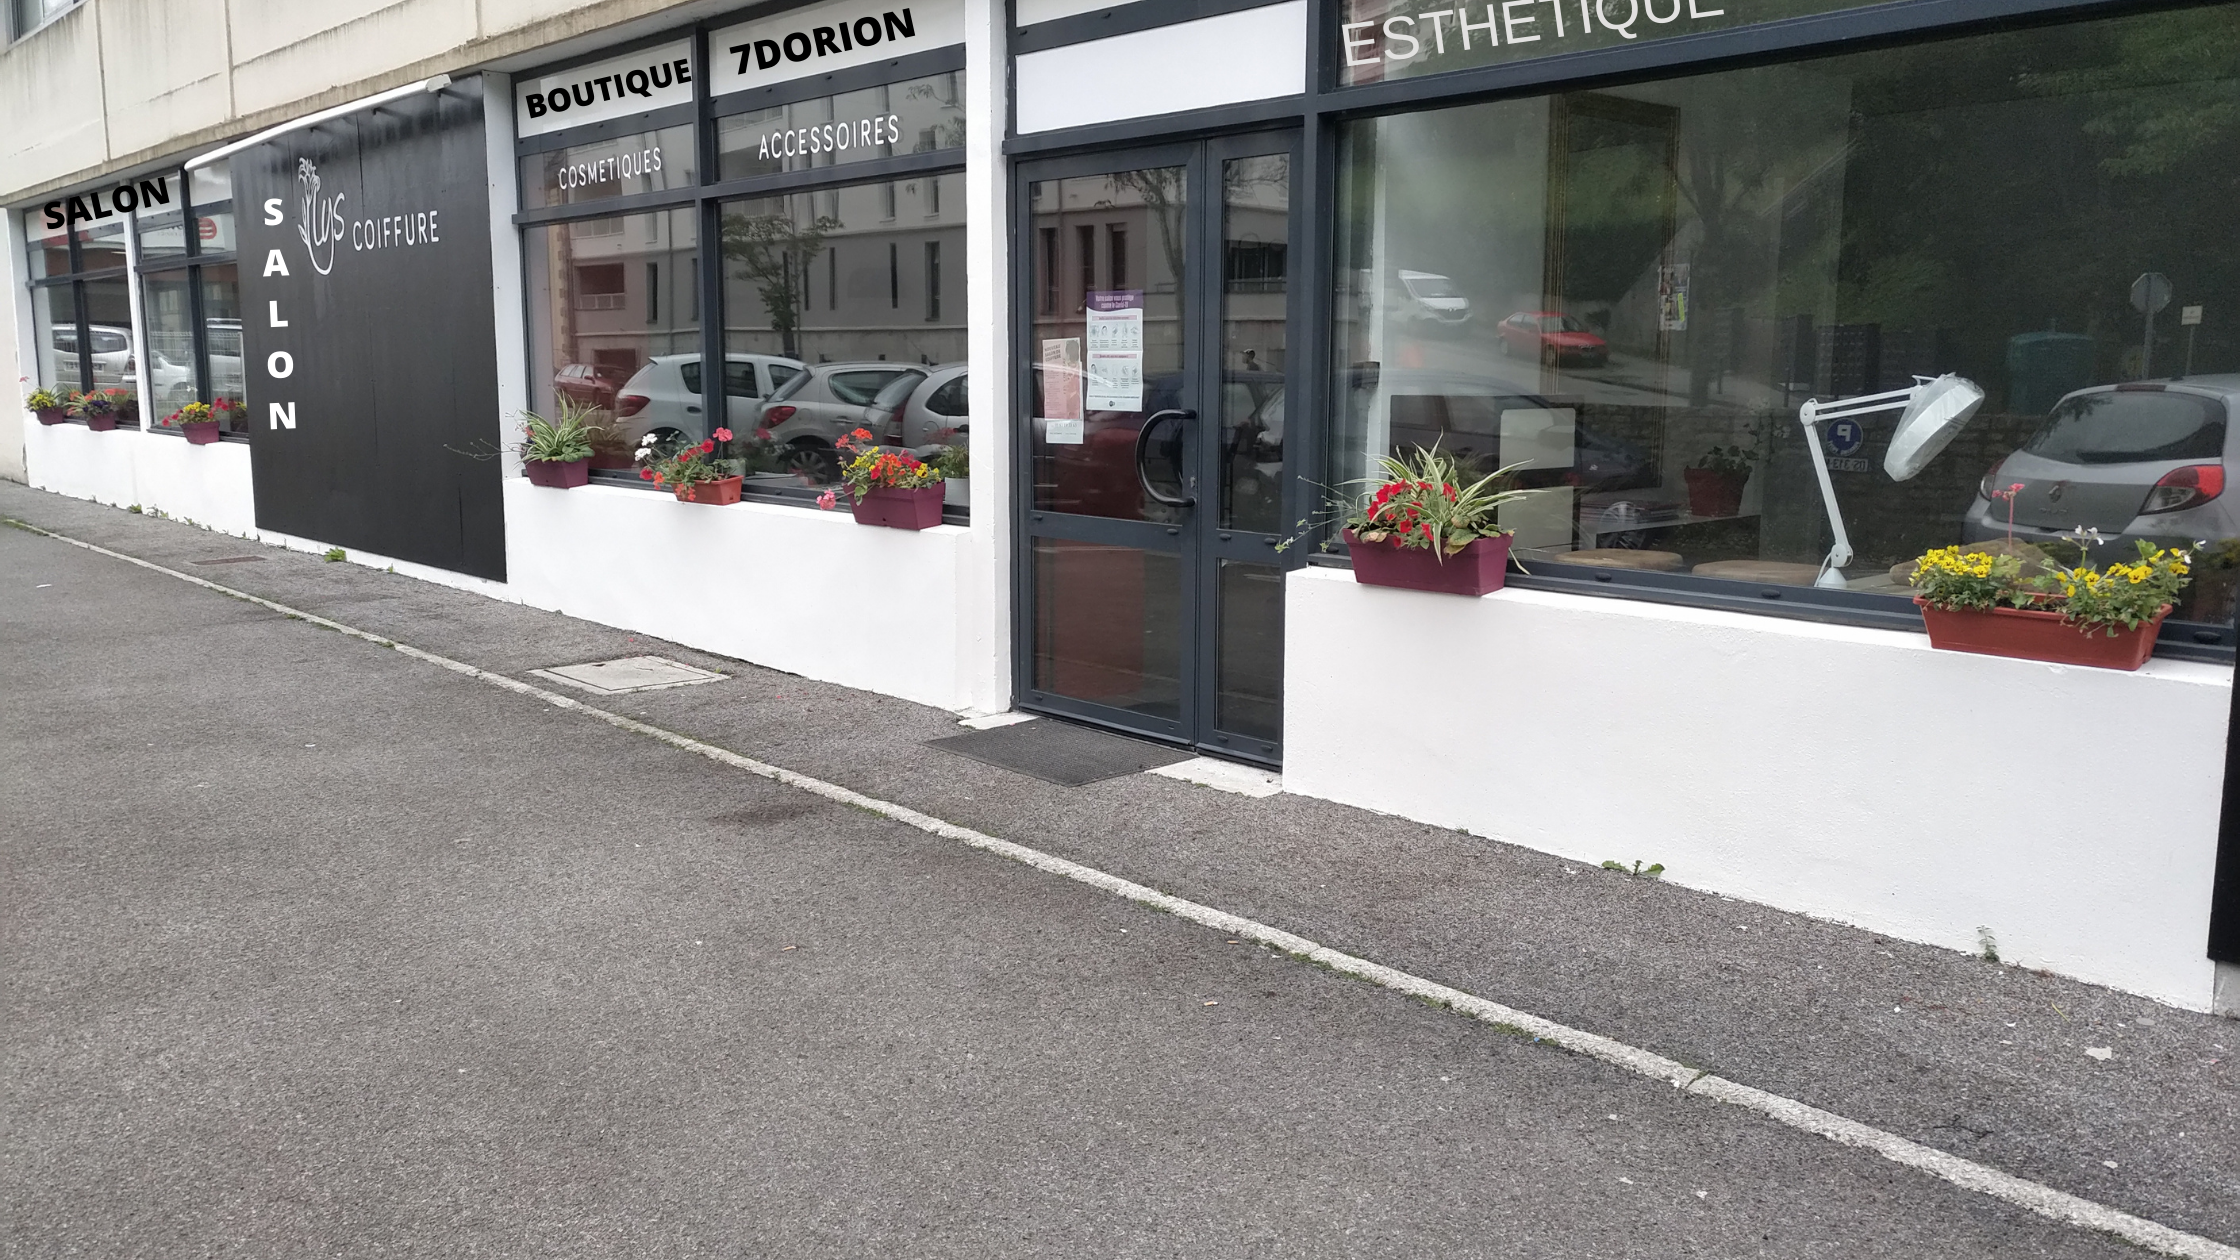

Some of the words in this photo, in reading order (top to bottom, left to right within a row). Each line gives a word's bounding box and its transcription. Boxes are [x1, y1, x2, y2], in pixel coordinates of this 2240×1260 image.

[758, 114, 900, 161] ACCESSOIRES
[558, 146, 663, 190] COSMETIQUES
[353, 210, 440, 251] COIFFURE
